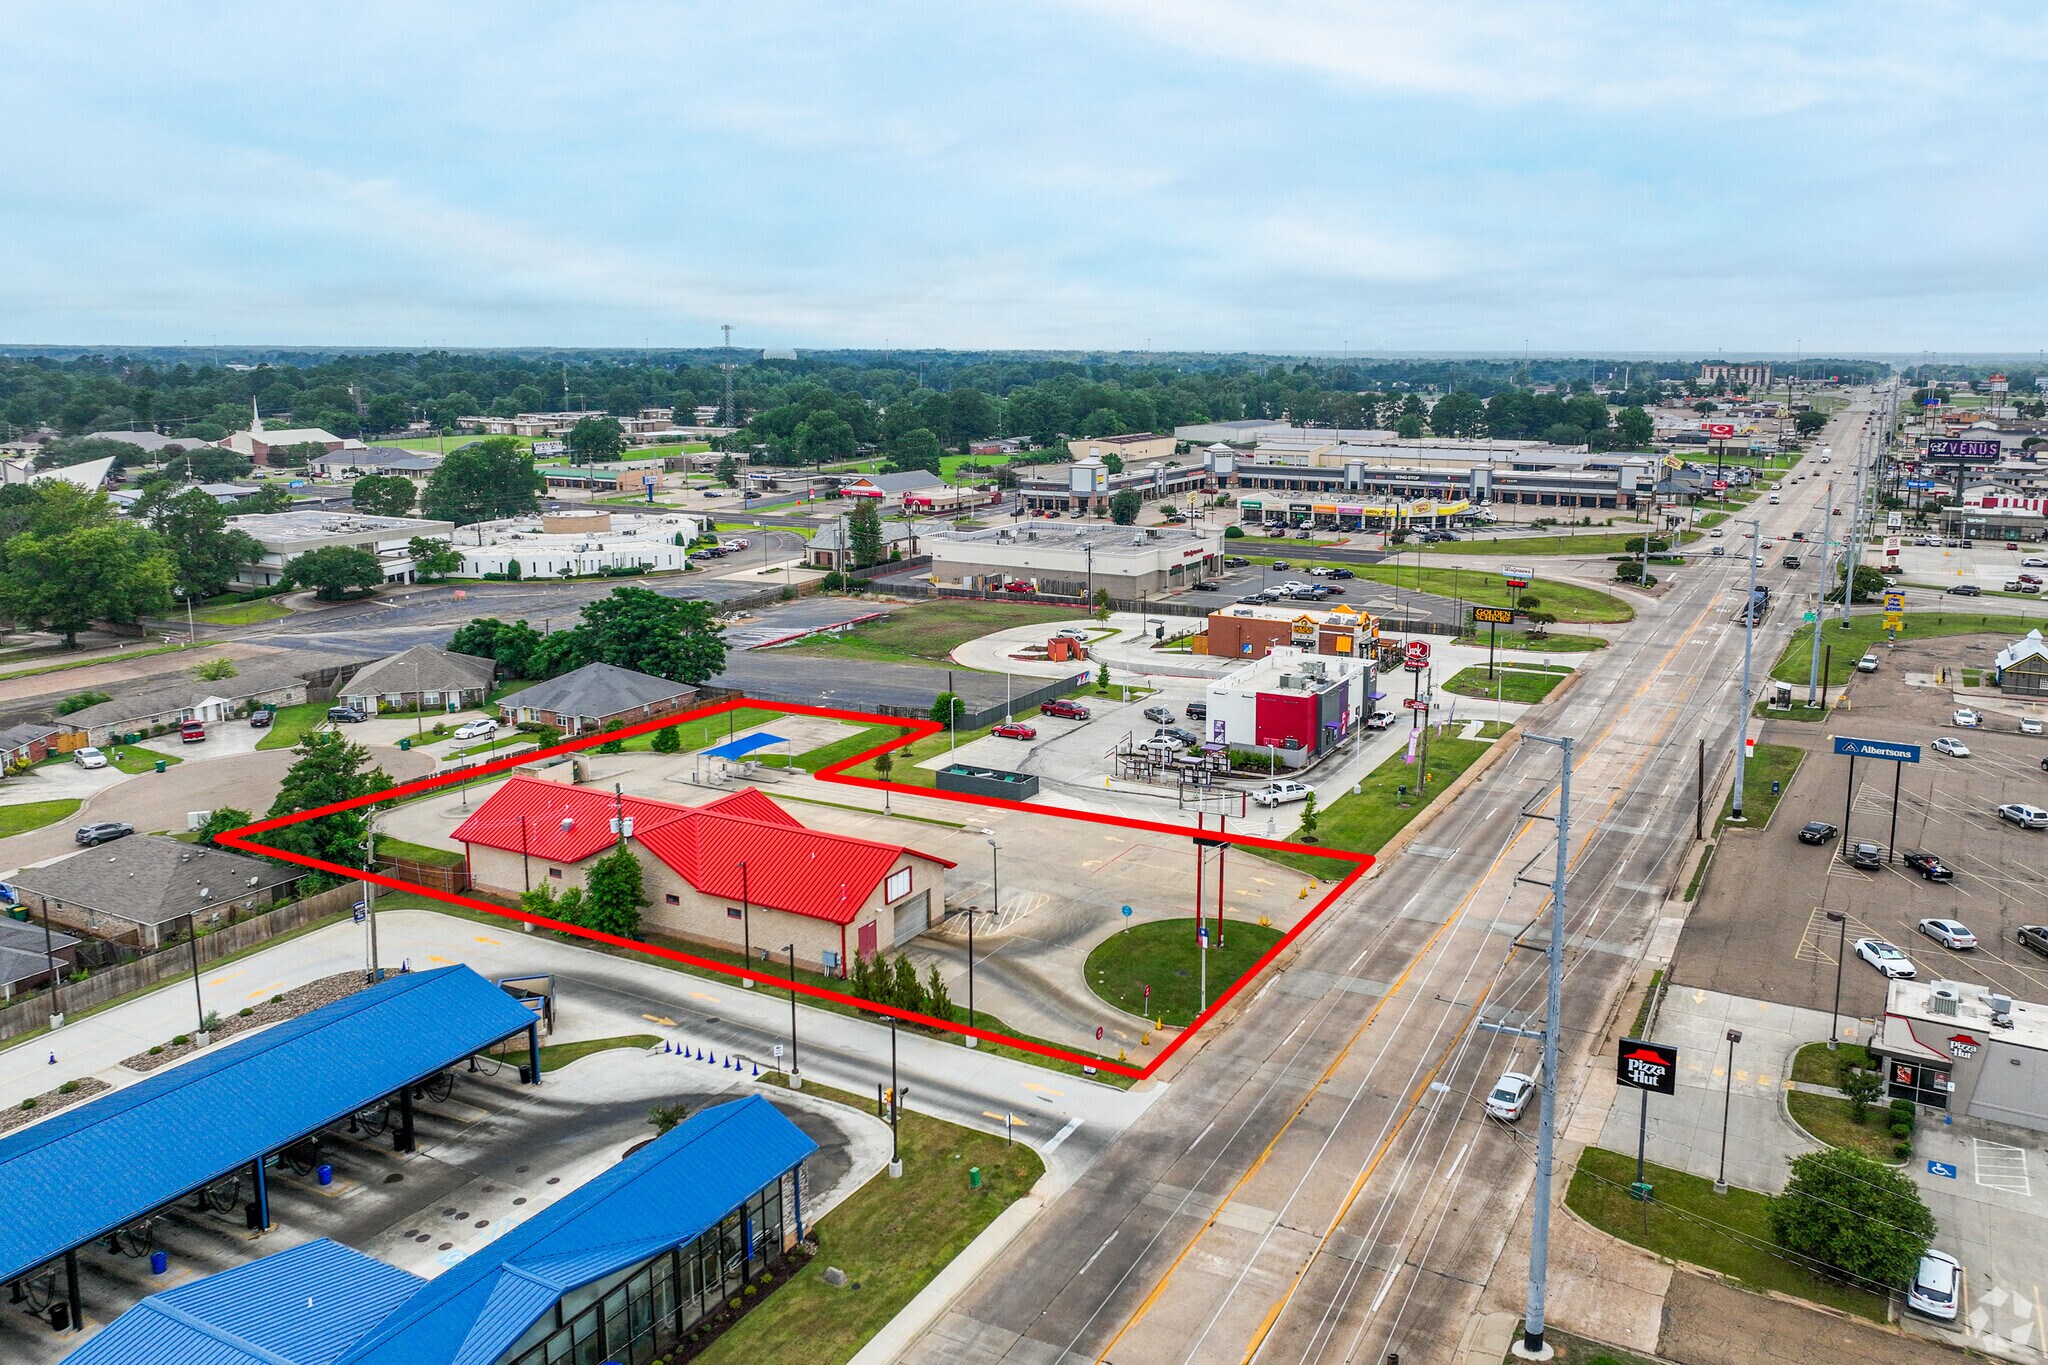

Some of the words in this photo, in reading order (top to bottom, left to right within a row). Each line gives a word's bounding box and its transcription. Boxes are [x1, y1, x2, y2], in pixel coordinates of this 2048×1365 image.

[1950, 442, 1997, 455] VENUS
[1504, 566, 1531, 574] Walgreens
[1476, 608, 1511, 617] GOLDEN
[1409, 643, 1427, 656] Jack
[1861, 745, 1912, 758] Albertsons
[1950, 1040, 1977, 1052] Pizza
[1950, 1048, 1972, 1059] Hut
[1628, 1058, 1666, 1075] Pizza
[1628, 1070, 1659, 1086] Hut
